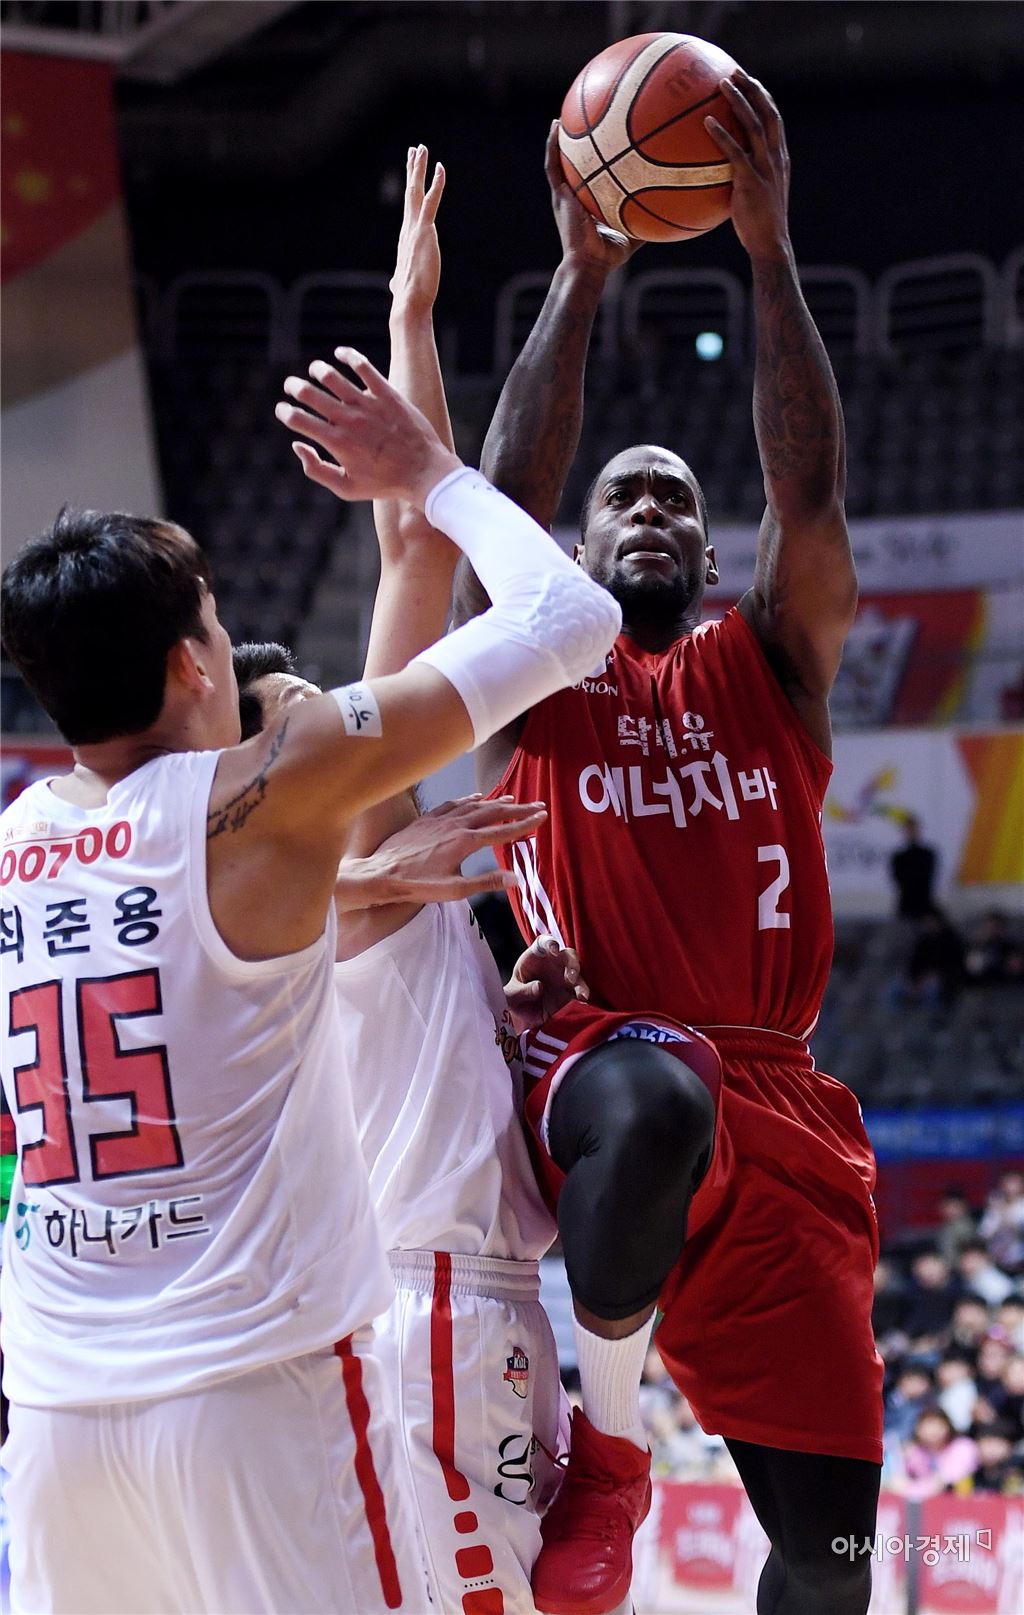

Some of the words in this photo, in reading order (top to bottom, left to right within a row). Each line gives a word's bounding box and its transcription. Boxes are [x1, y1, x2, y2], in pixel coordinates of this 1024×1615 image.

[571, 680, 618, 697] RION
[0, 821, 132, 886] 00700
[757, 844, 791, 931] 2
[8, 968, 184, 1188] 35
[44, 1196, 210, 1258] 하나카드
